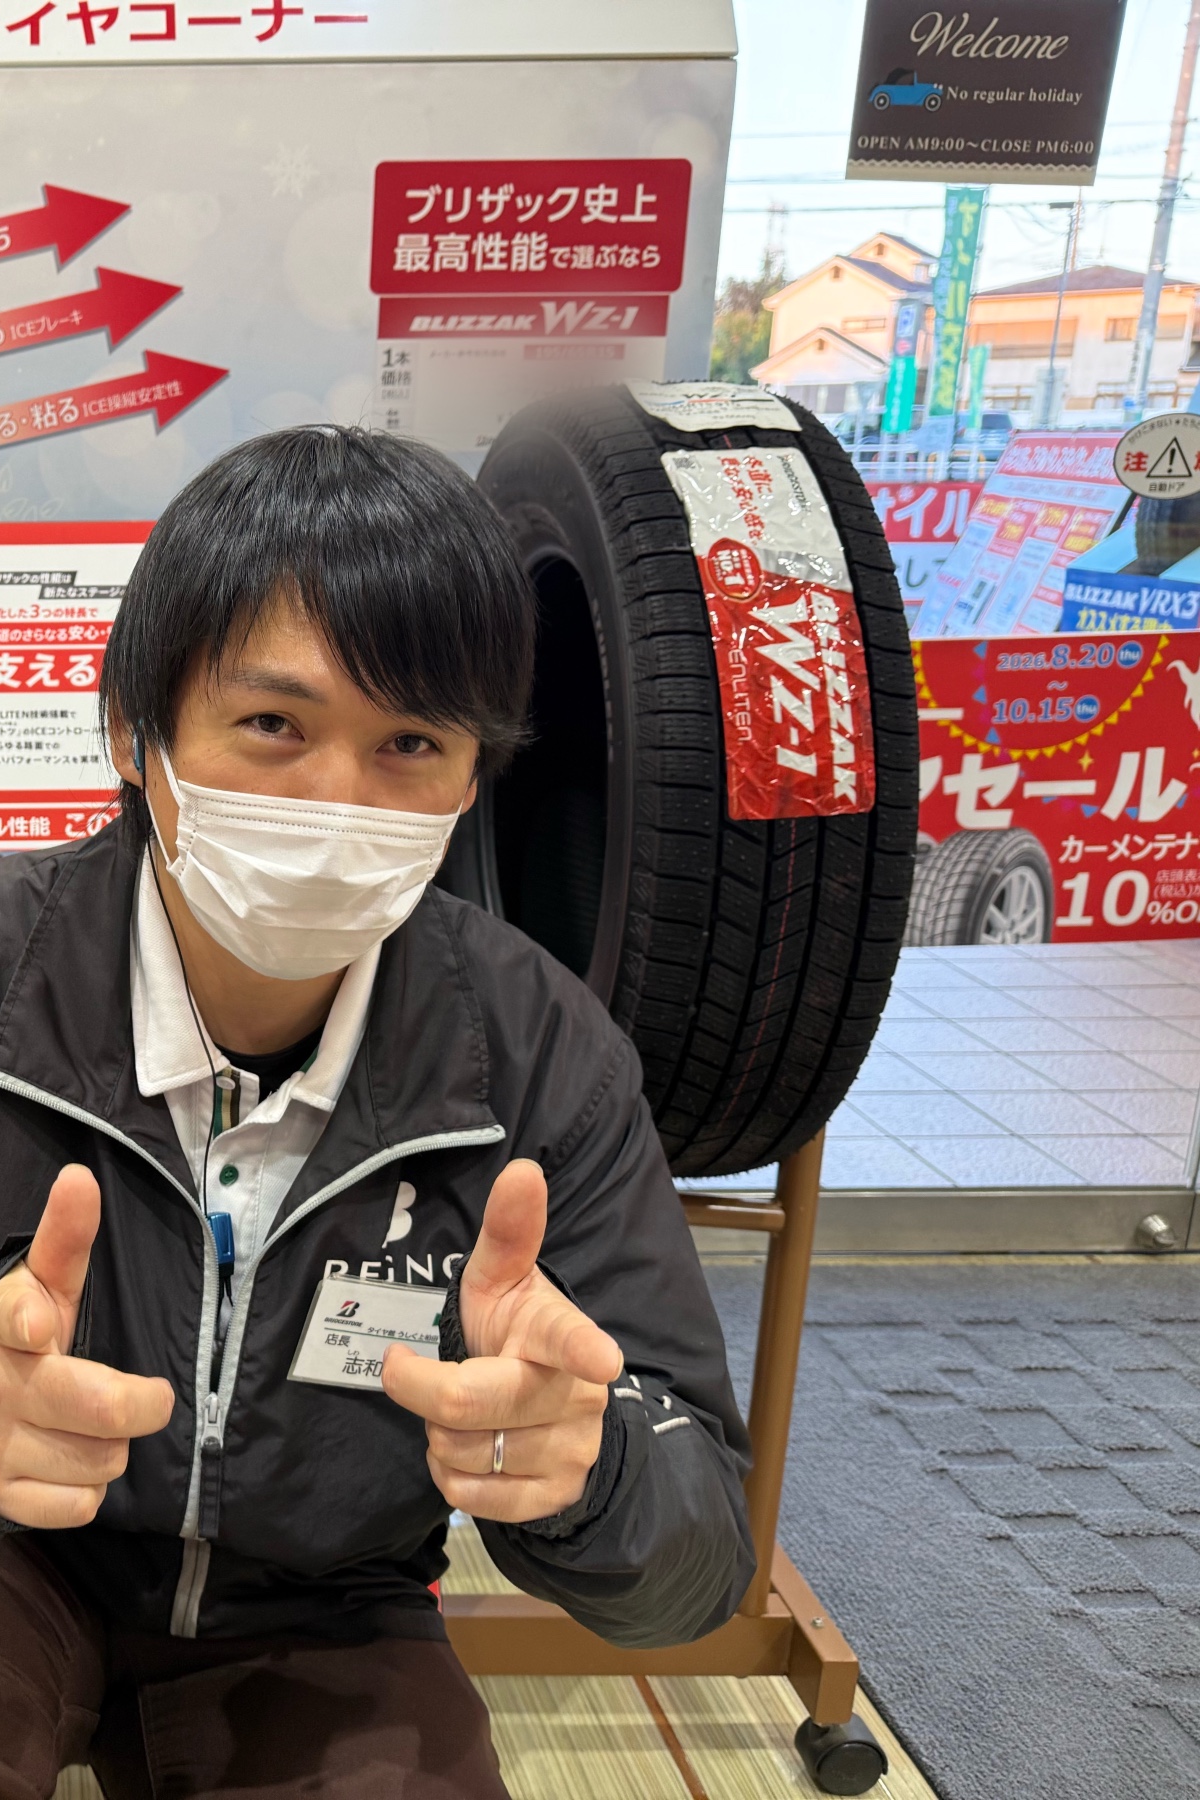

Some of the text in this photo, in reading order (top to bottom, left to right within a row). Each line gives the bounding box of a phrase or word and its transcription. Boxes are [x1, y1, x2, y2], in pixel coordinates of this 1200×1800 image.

[910, 11, 1069, 60] Welcome
[946, 87, 1083, 105] No regular holiday
[857, 136, 900, 150] OPEN
[1036, 140, 1095, 154] PM6:00
[405, 183, 658, 224] ブリザック史上
[393, 231, 661, 273] 最高性能で選ぶなら
[9, 309, 84, 341] ICEブレーキ
[409, 301, 640, 334] BLIZZAK WZ-1
[381, 349, 411, 368] 1本
[1123, 451, 1149, 472] 注
[996, 642, 1116, 671] 2026.8.20
[809, 590, 858, 806] BLIZZAK
[992, 697, 1074, 724] 10.15
[1059, 831, 1200, 865] カーメンテナ
[1055, 868, 1200, 928] 10%O
[324, 1316, 363, 1328] BRIDGESTONE
[324, 1333, 351, 1348] 店長
